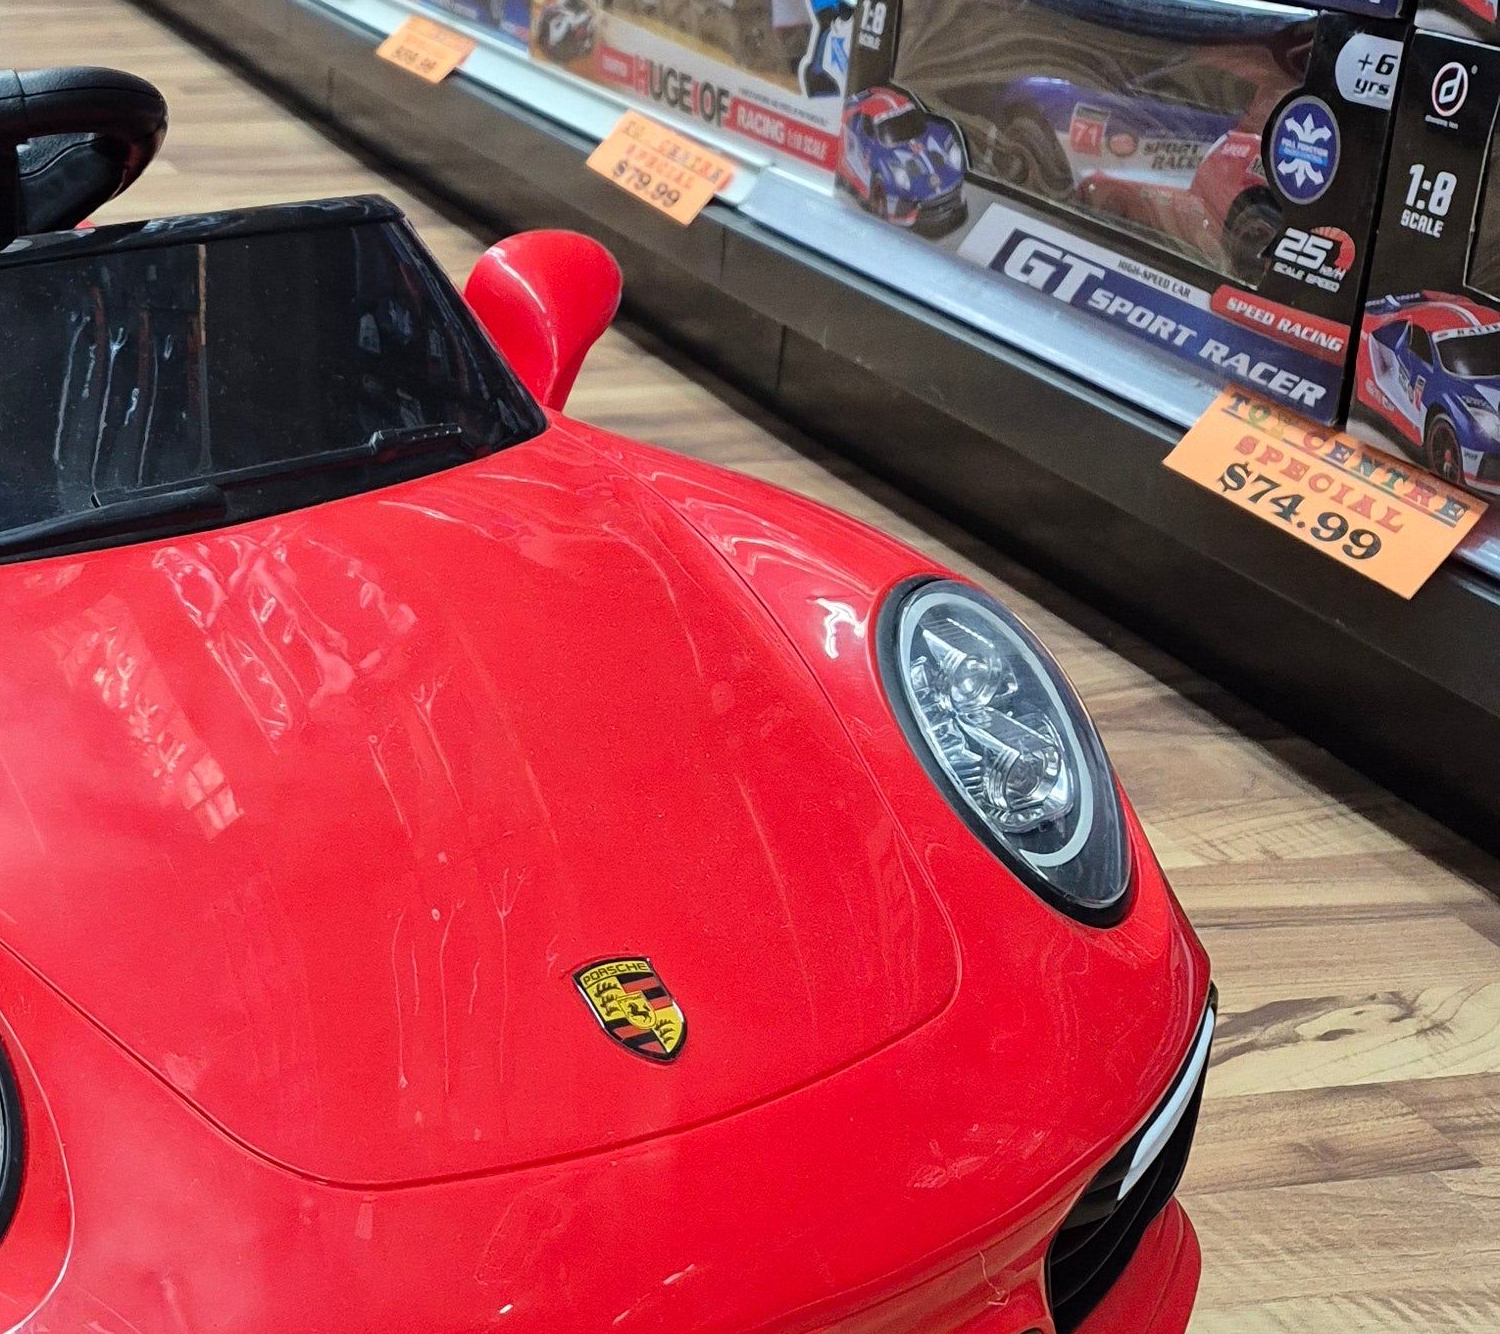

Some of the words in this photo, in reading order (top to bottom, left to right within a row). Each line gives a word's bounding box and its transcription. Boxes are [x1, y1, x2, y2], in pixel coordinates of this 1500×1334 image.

[1354, 78, 1390, 96] yrs
[1358, 53, 1399, 76] +6
[635, 53, 693, 114] HUGE
[699, 84, 730, 128] OF
[737, 102, 785, 142] RACING
[1075, 124, 1100, 146] 71
[613, 159, 680, 208] $79.99
[1405, 163, 1457, 217] 1:8
[1400, 208, 1444, 239] SCALE
[1274, 227, 1334, 268] 25
[1118, 259, 1171, 291] HIGH-SPEED
[1171, 281, 1191, 299] CAR
[1273, 260, 1305, 281] SCALE
[1304, 273, 1340, 294] SPEED
[1004, 237, 1105, 304] GT
[1088, 290, 1197, 348] SPORT
[1199, 337, 1328, 408] RACER
[1226, 296, 1275, 327] SPEED
[1277, 317, 1345, 354] RACING
[1227, 391, 1294, 439] TOY
[1302, 430, 1472, 523] CENTRE
[1235, 434, 1405, 534] SPECIAL
[1217, 461, 1383, 561] $74.99
[583, 962, 649, 985] PORSCHE
